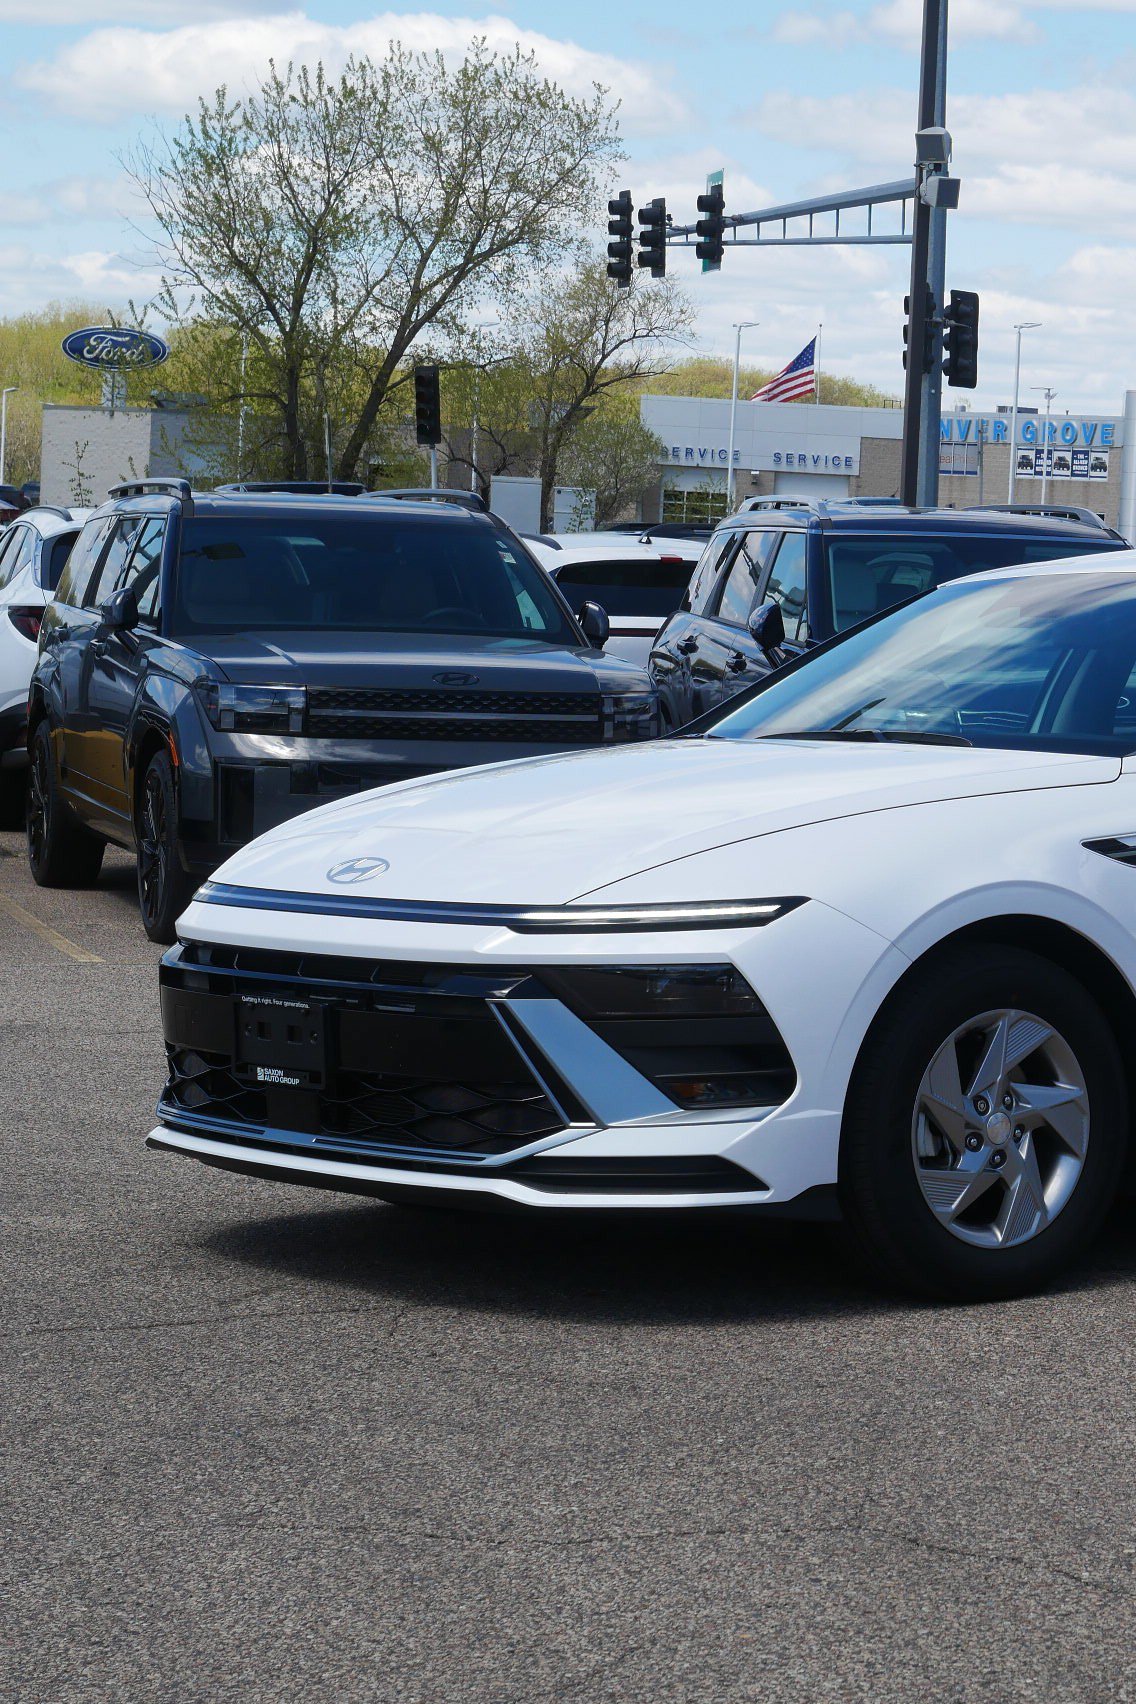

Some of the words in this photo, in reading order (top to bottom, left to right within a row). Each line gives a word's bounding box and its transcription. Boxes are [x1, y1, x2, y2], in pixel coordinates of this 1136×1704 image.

[83, 334, 150, 361] Ford
[1021, 420, 1115, 446] GROVE
[661, 446, 741, 461] SERVICE
[773, 452, 854, 467] SERVICE
[264, 1067, 284, 1077] SAXON
[264, 1074, 280, 1083] AUTO
[279, 1076, 300, 1085] GROUP
